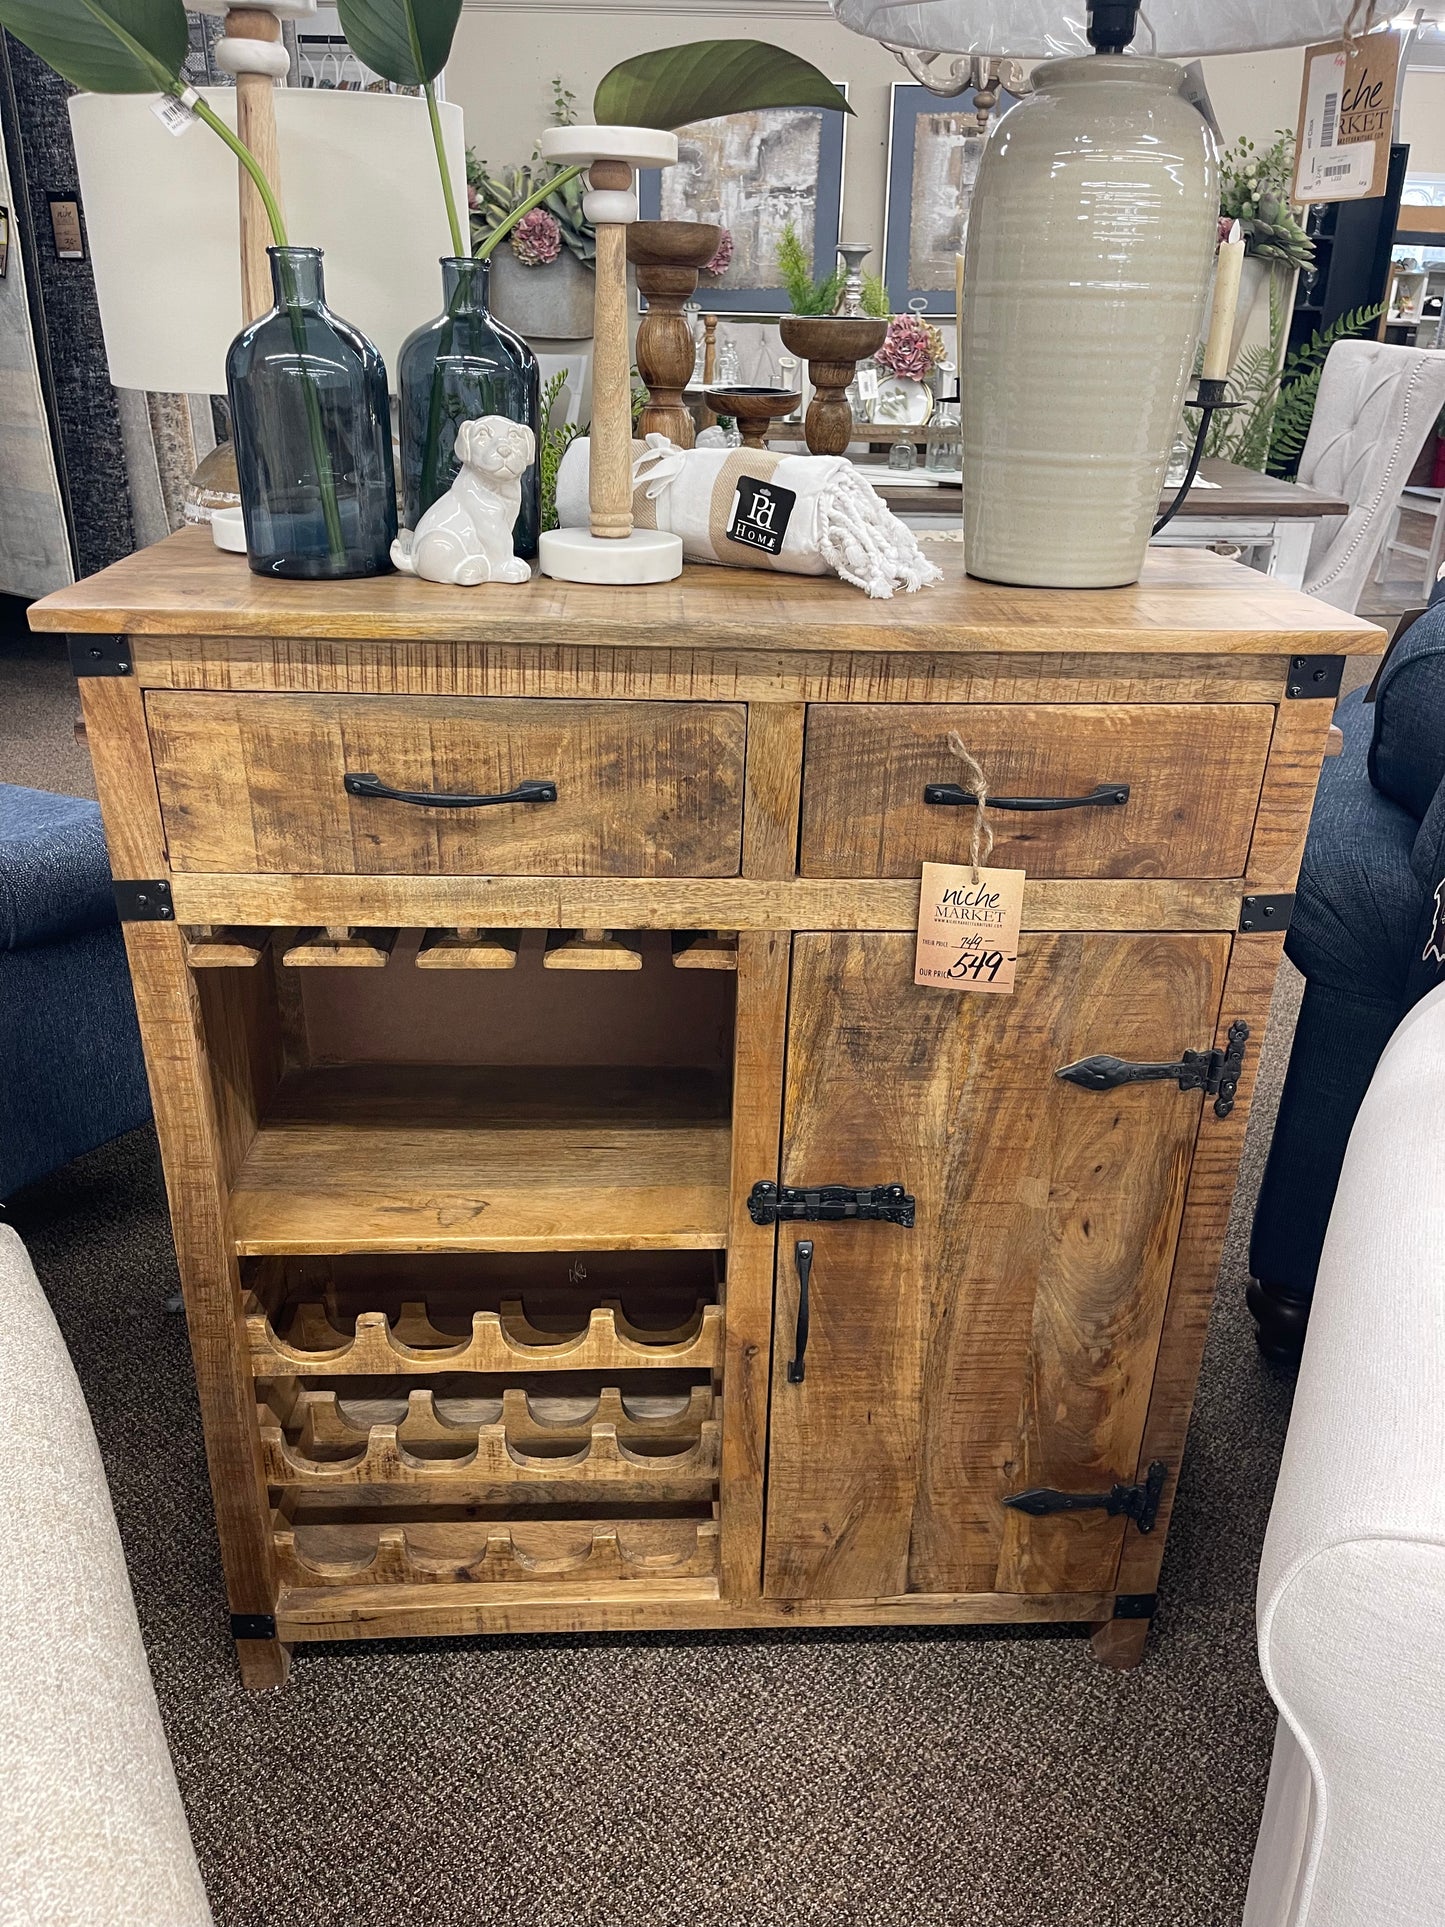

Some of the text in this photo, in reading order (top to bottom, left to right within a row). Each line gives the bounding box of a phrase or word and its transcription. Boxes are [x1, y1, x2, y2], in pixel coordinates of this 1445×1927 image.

[1341, 68, 1383, 112] che
[1339, 110, 1389, 135] RKET
[942, 882, 1000, 908] niche
[934, 906, 1006, 923] MARKET
[919, 968, 932, 977] OUR
